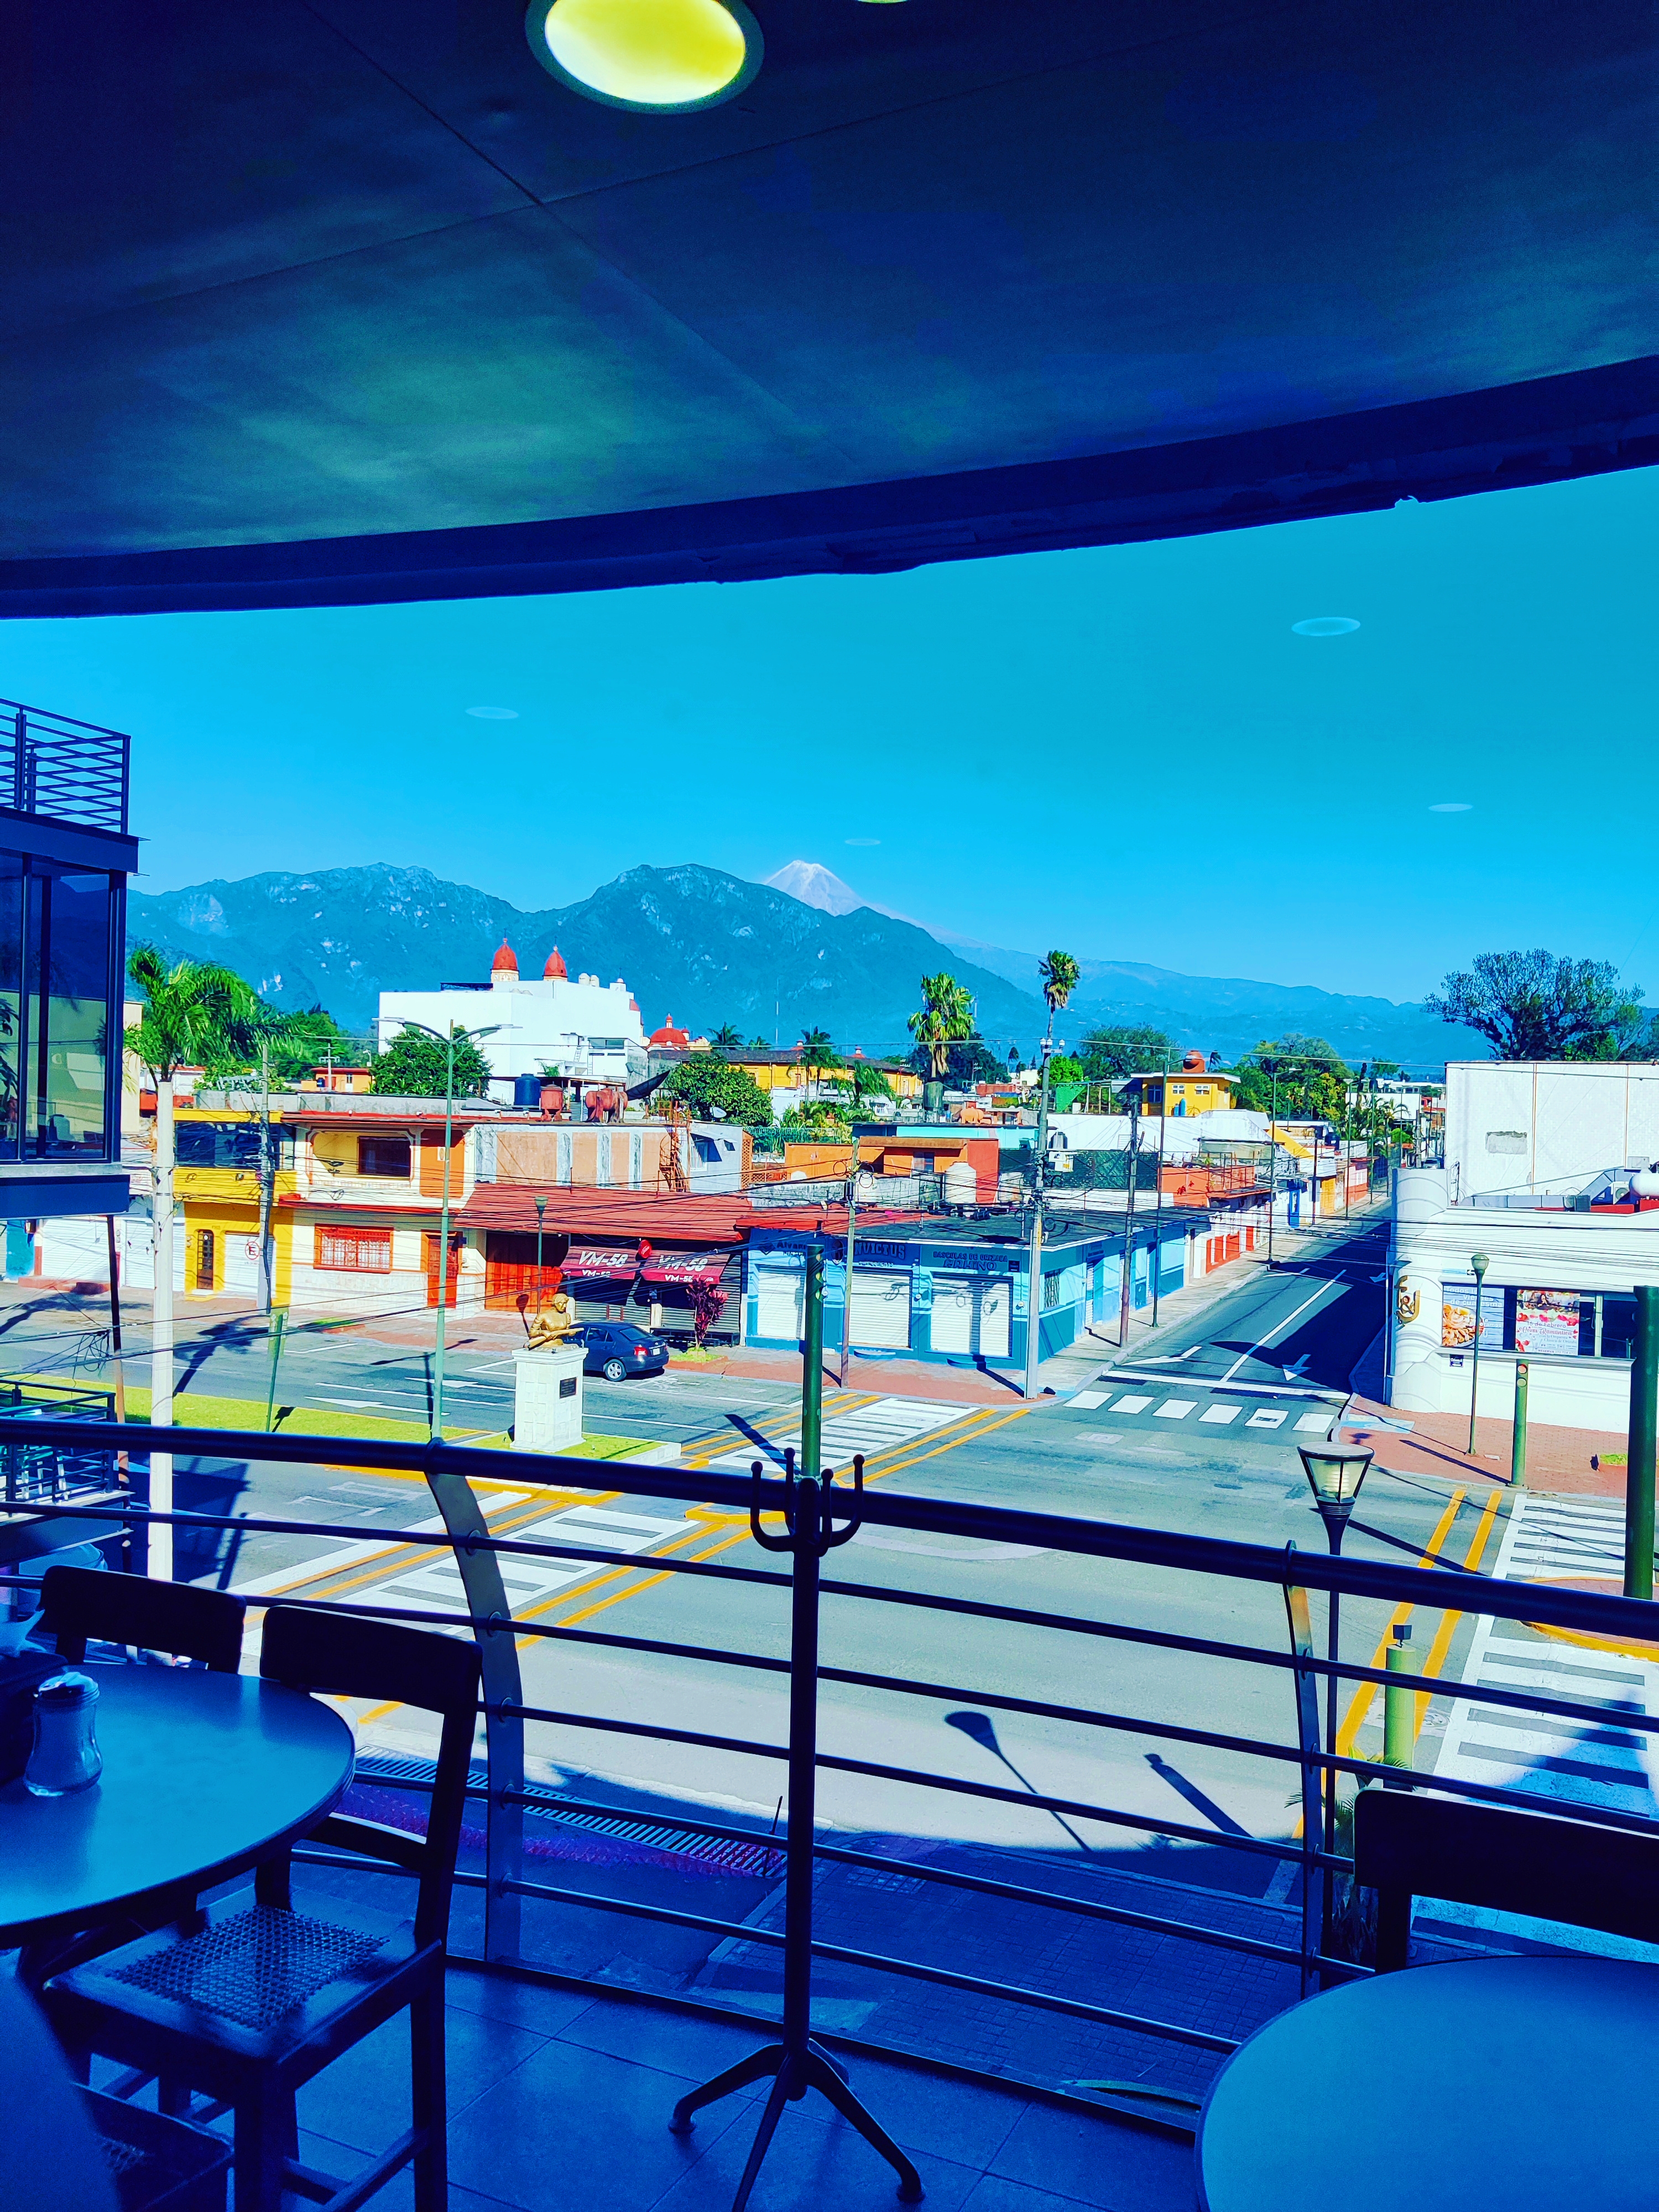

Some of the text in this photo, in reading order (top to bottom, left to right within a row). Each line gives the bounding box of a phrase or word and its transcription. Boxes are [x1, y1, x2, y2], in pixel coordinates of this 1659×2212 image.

[849, 1242, 905, 1259] NVICTUS
[933, 1251, 967, 1260] BASCULAS
[980, 1254, 1008, 1262] ORIZABA
[578, 1251, 629, 1267] VM-58
[657, 1255, 709, 1272] VM-58
